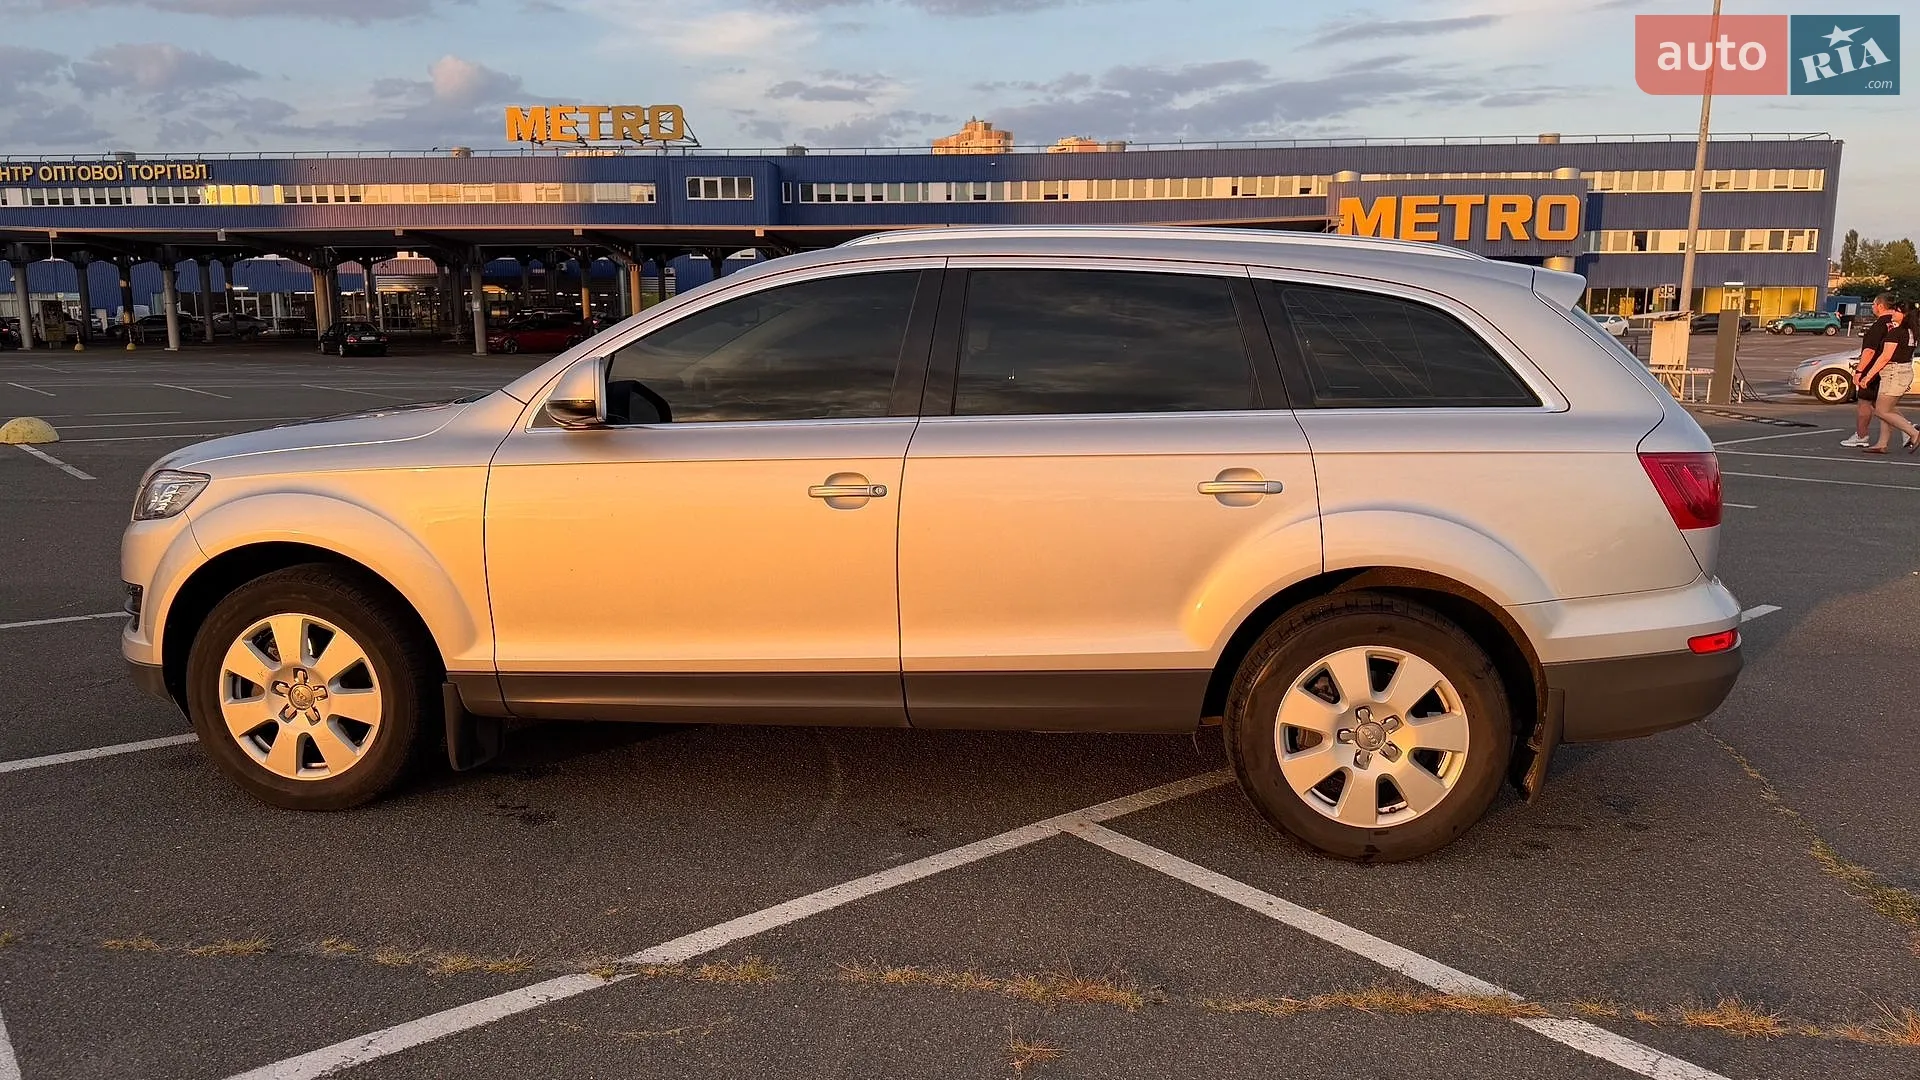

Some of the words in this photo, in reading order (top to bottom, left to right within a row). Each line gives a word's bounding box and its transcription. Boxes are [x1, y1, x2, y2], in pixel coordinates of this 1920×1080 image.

[505, 104, 684, 141] METRO
[38, 162, 124, 181] ОПТОВОЇ
[1338, 194, 1581, 241] METRO
